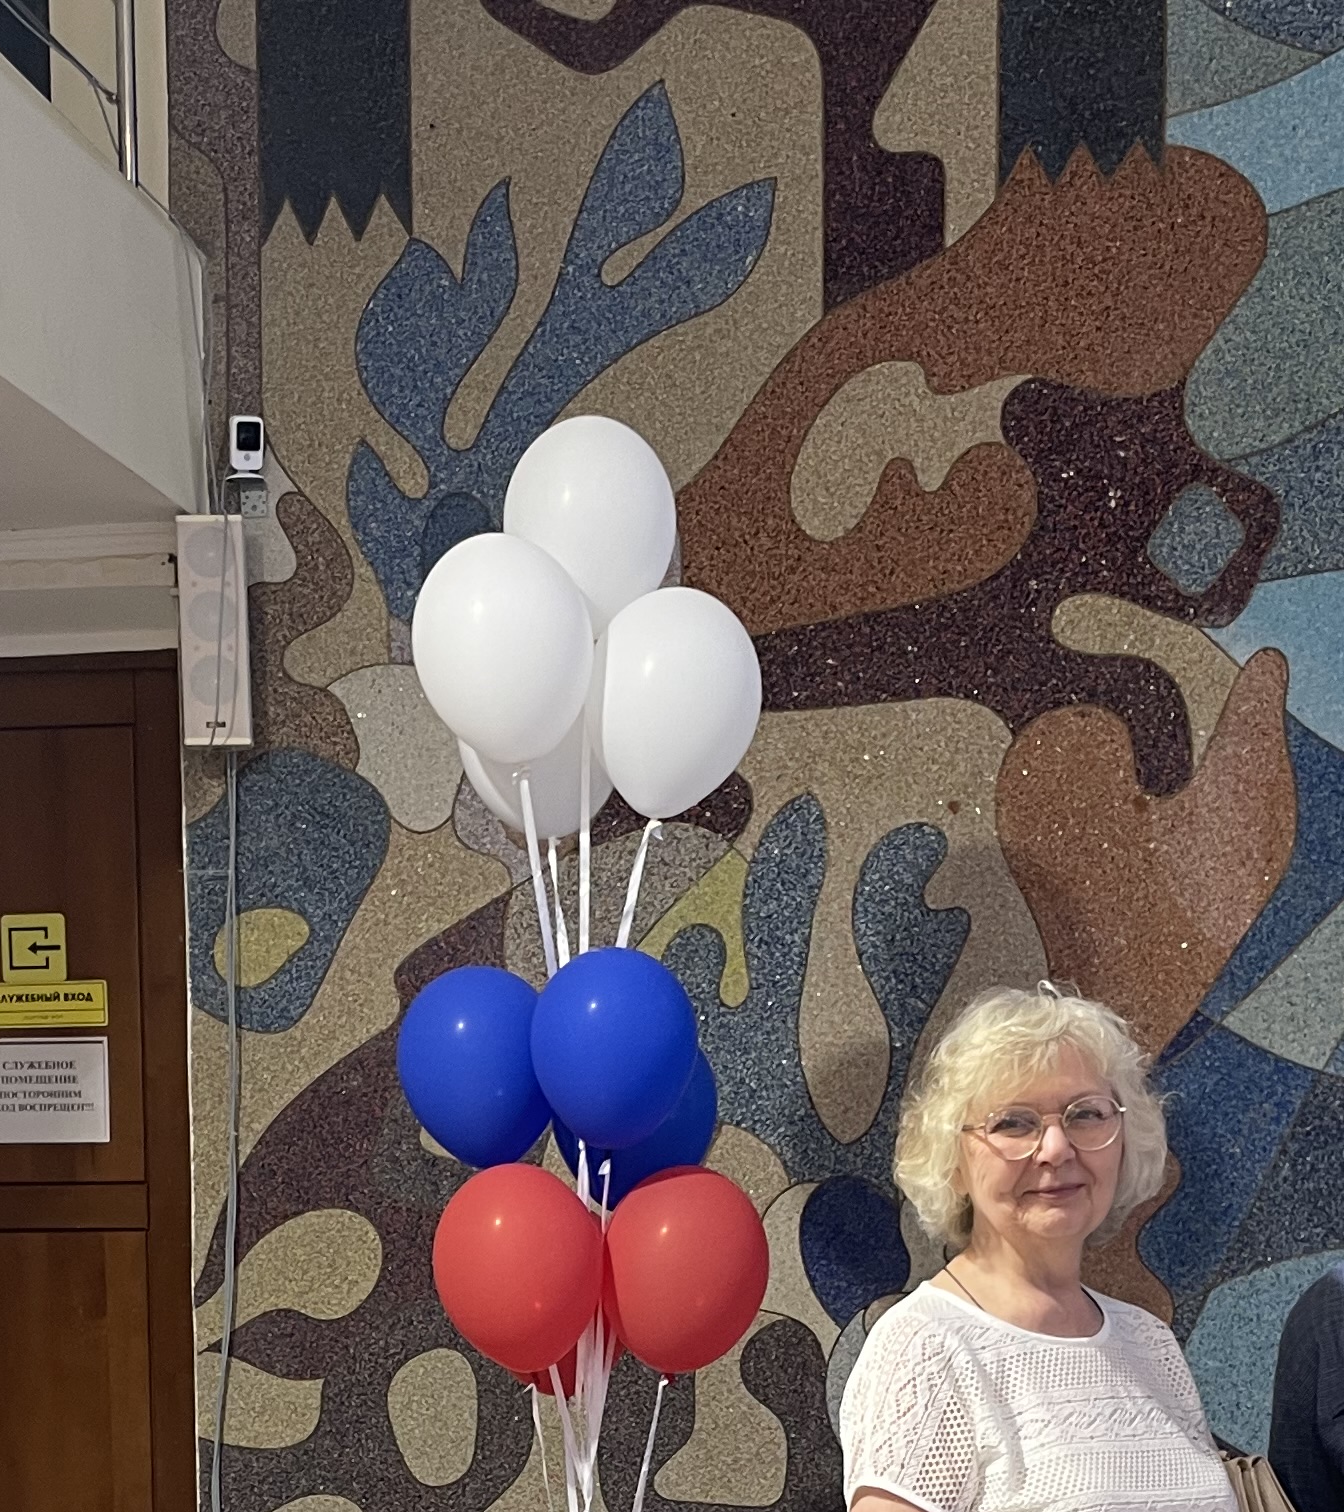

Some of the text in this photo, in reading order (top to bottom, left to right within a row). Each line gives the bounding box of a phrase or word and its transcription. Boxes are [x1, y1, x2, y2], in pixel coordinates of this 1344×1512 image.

[63, 992, 94, 1003] ВХОД
[2, 1060, 77, 1071] СЛУЖЕБНОЕ
[0, 1075, 79, 1085] ПОМЕЩЕНИЕ
[0, 1090, 82, 1099] ПОСТОРОННИМ
